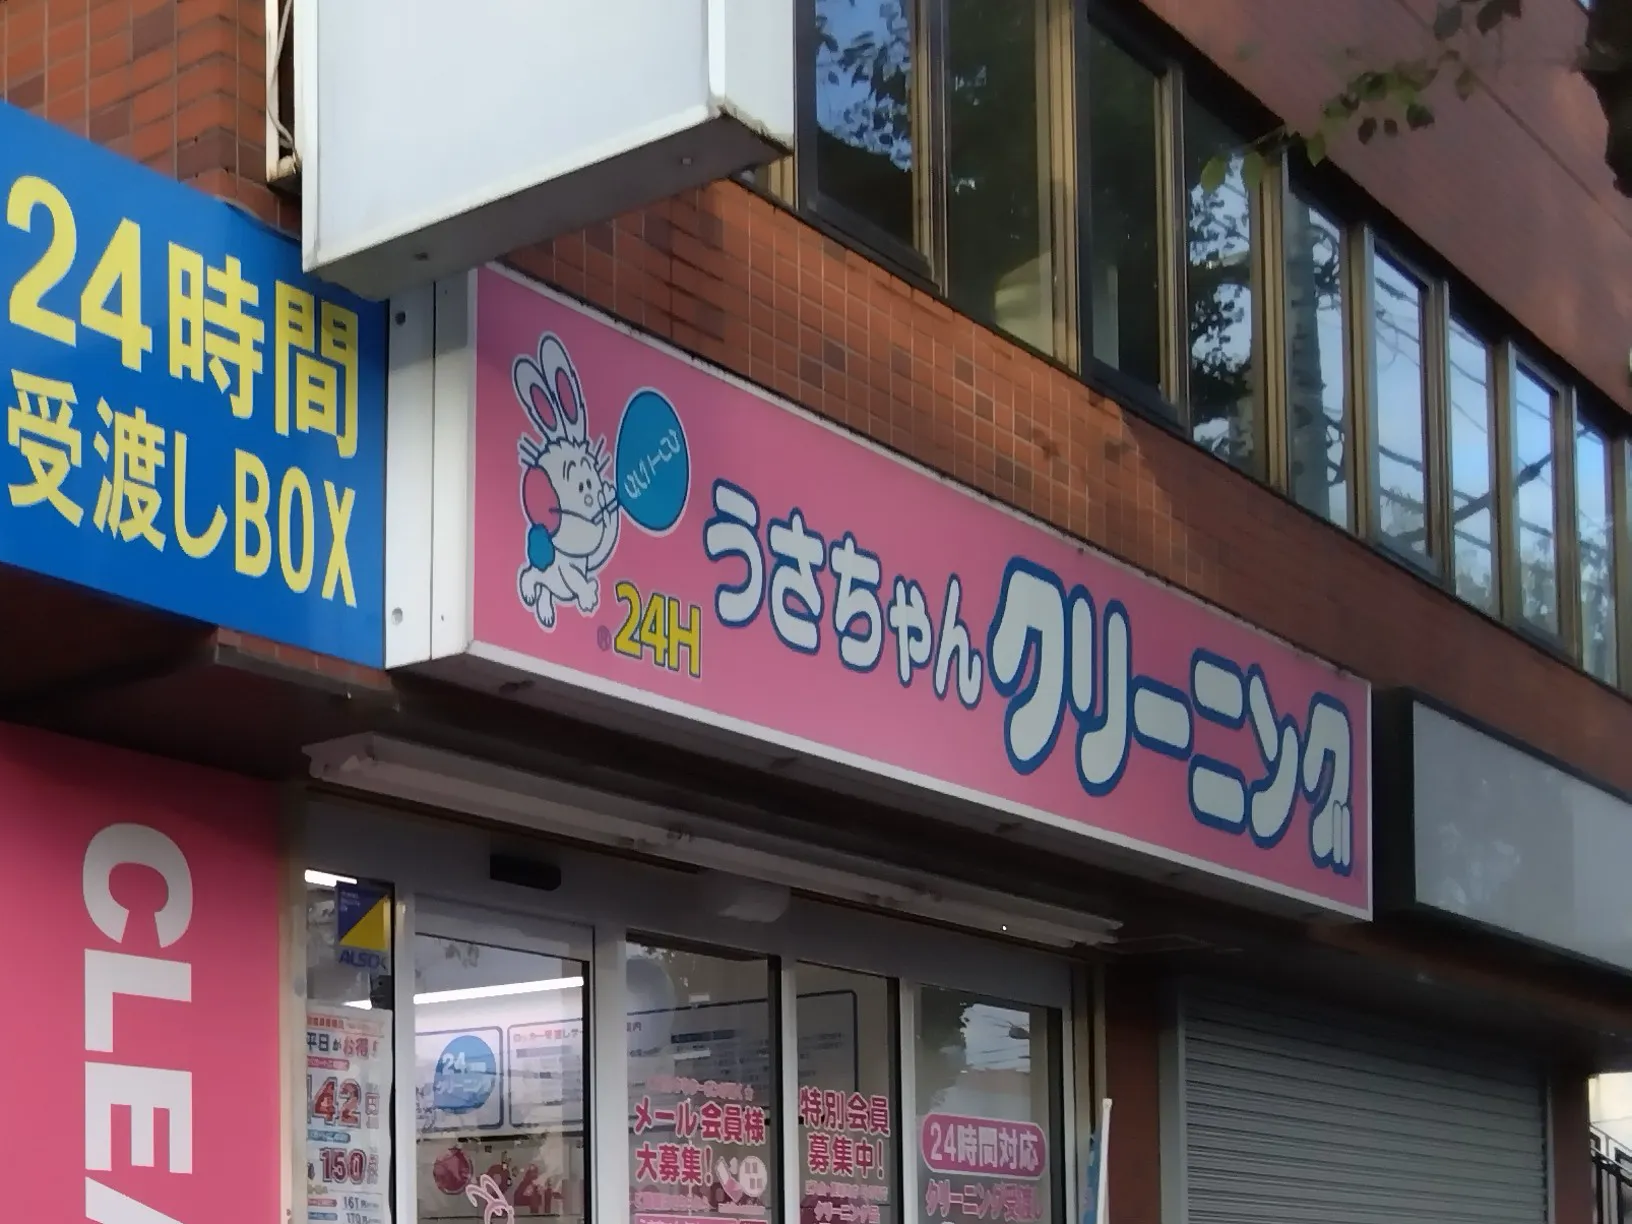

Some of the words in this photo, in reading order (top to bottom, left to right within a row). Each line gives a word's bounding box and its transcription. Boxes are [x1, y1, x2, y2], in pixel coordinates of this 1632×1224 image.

[5, 174, 359, 460] 24時間
[6, 368, 359, 608] 受渡しBOX
[613, 578, 703, 679] 24H
[799, 1086, 891, 1137] 特別会員
[930, 1122, 1039, 1172] 24時間対応
